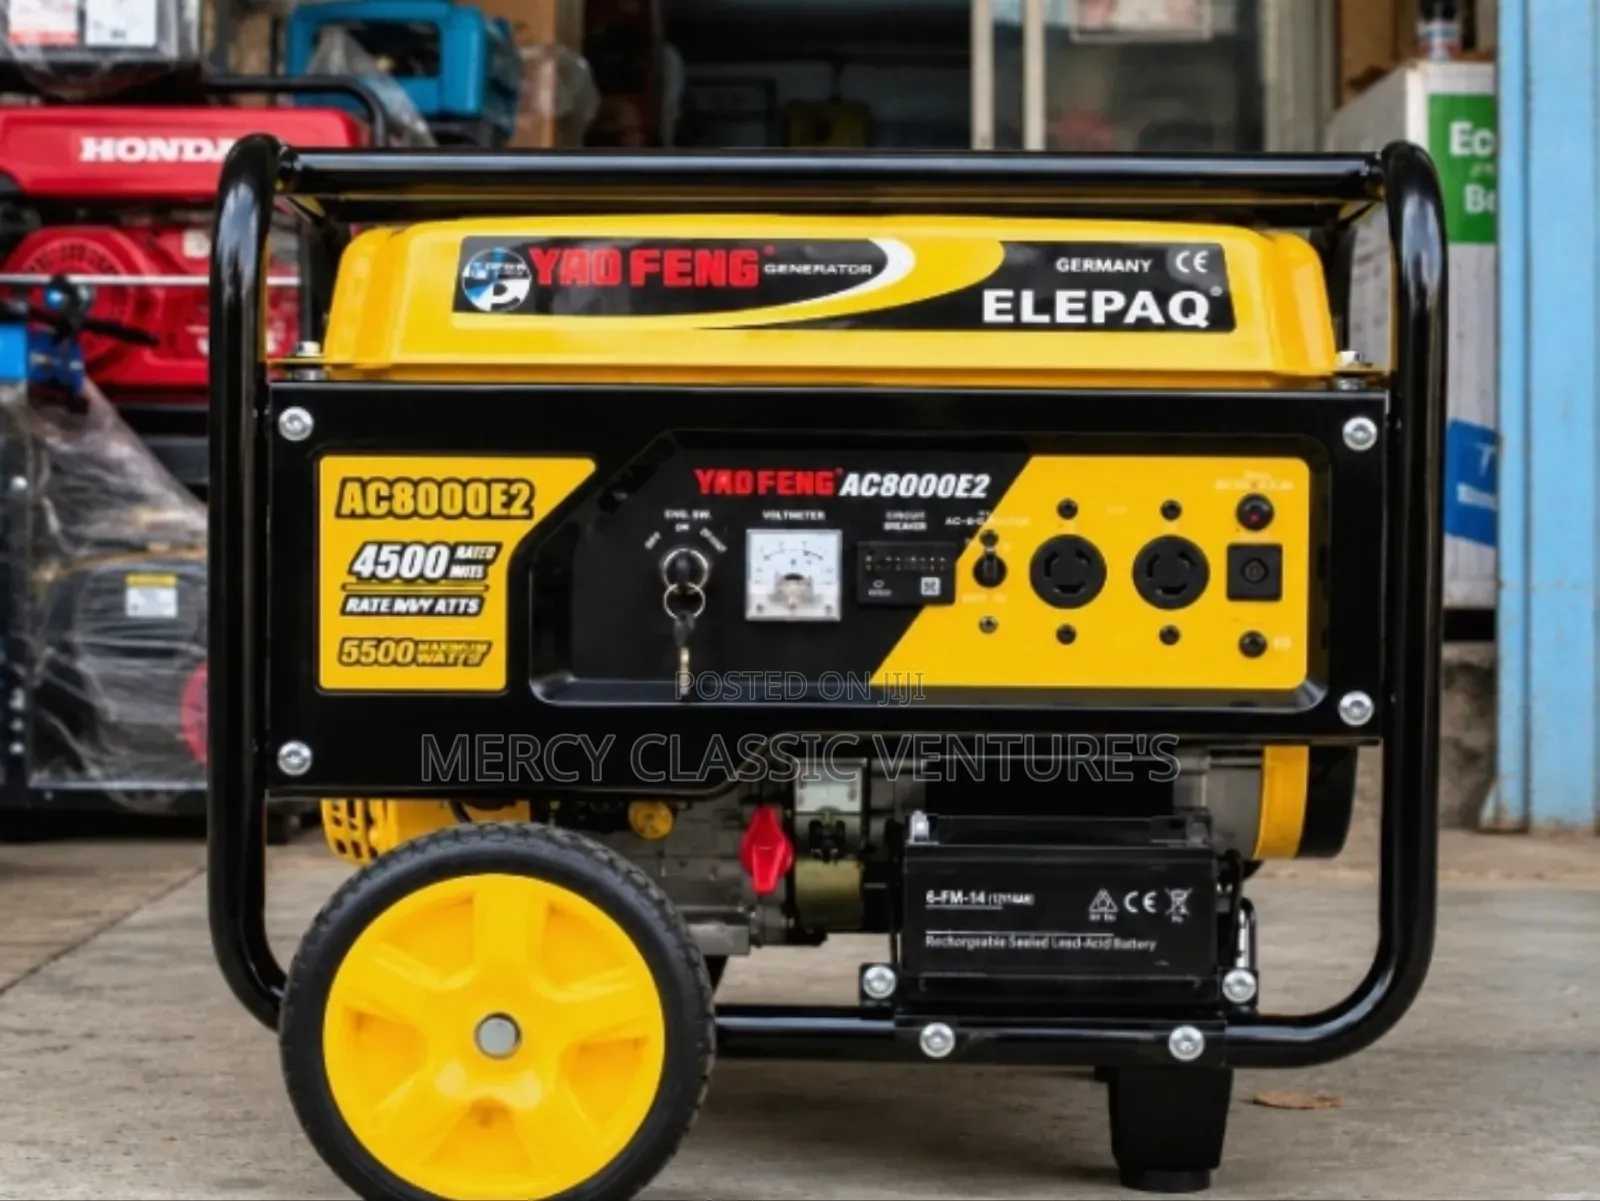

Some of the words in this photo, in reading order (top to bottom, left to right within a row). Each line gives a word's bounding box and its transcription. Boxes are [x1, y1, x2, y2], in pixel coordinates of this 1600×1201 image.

[529, 247, 622, 286] YAO
[630, 248, 759, 287] FENG
[764, 263, 873, 275] GENERATOR
[1055, 256, 1152, 273] GERMANY
[983, 288, 1210, 328] ELEPAQ
[757, 471, 835, 497] FENG
[838, 471, 991, 498] AC8000E2
[336, 478, 534, 519] AC8000E2
[762, 510, 826, 520] VOLTMETER
[349, 541, 452, 582] 4500
[340, 638, 416, 665] 5500
[925, 890, 986, 905] 6-FM-14
[1114, 938, 1158, 953] Battery
